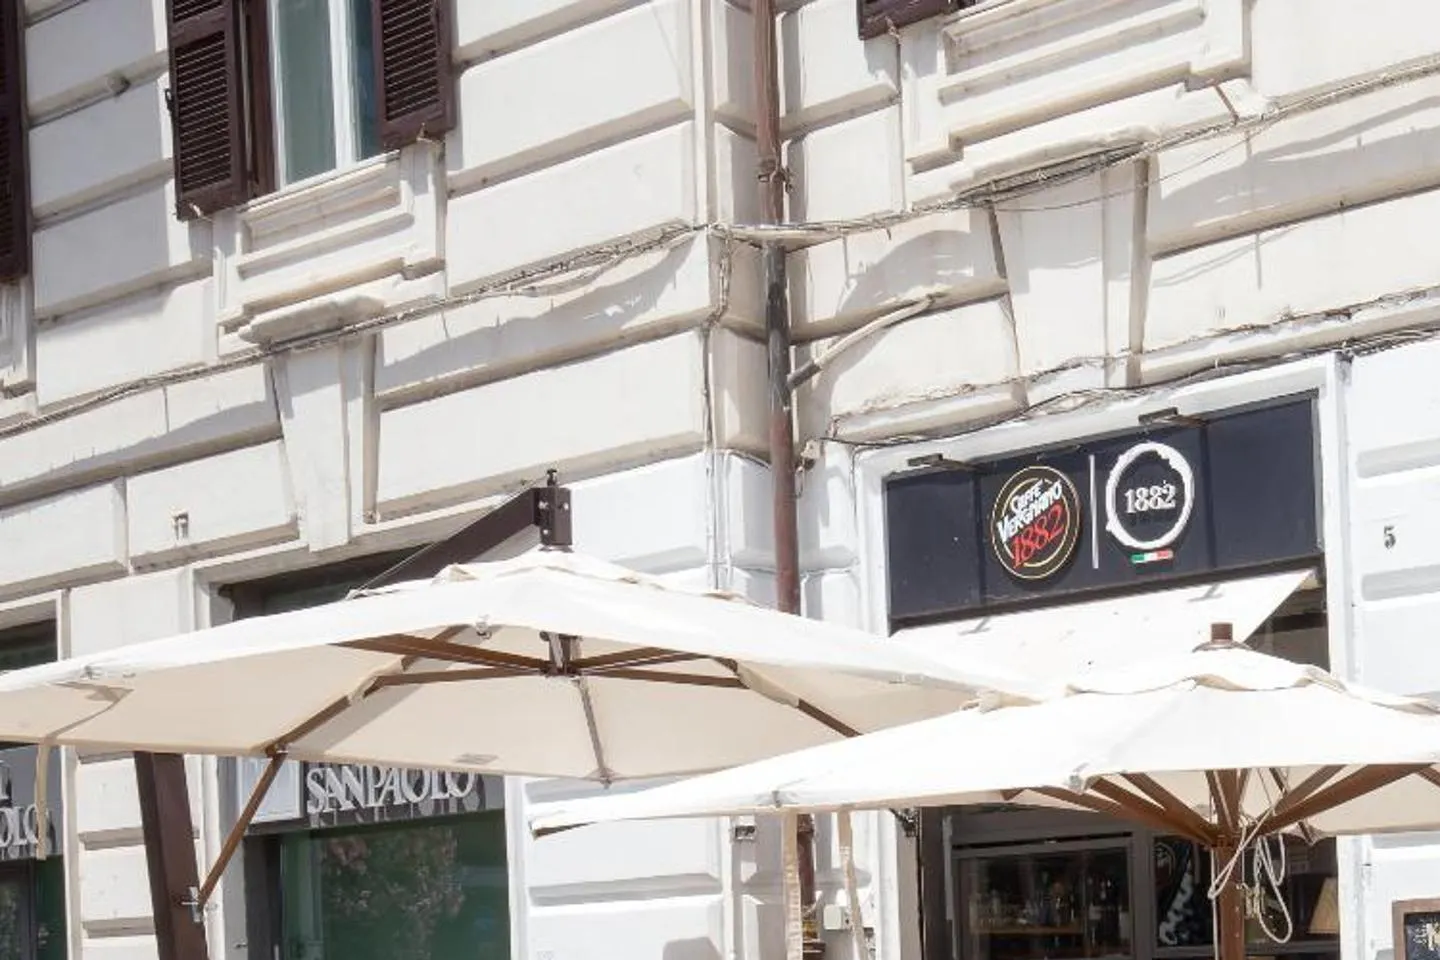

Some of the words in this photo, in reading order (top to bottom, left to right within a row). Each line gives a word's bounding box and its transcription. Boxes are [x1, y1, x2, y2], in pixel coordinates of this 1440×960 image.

[1124, 483, 1177, 514] 1882
[1012, 504, 1066, 569] 1882
[1383, 525, 1397, 550] 5
[306, 765, 477, 814] SANPAOLO
